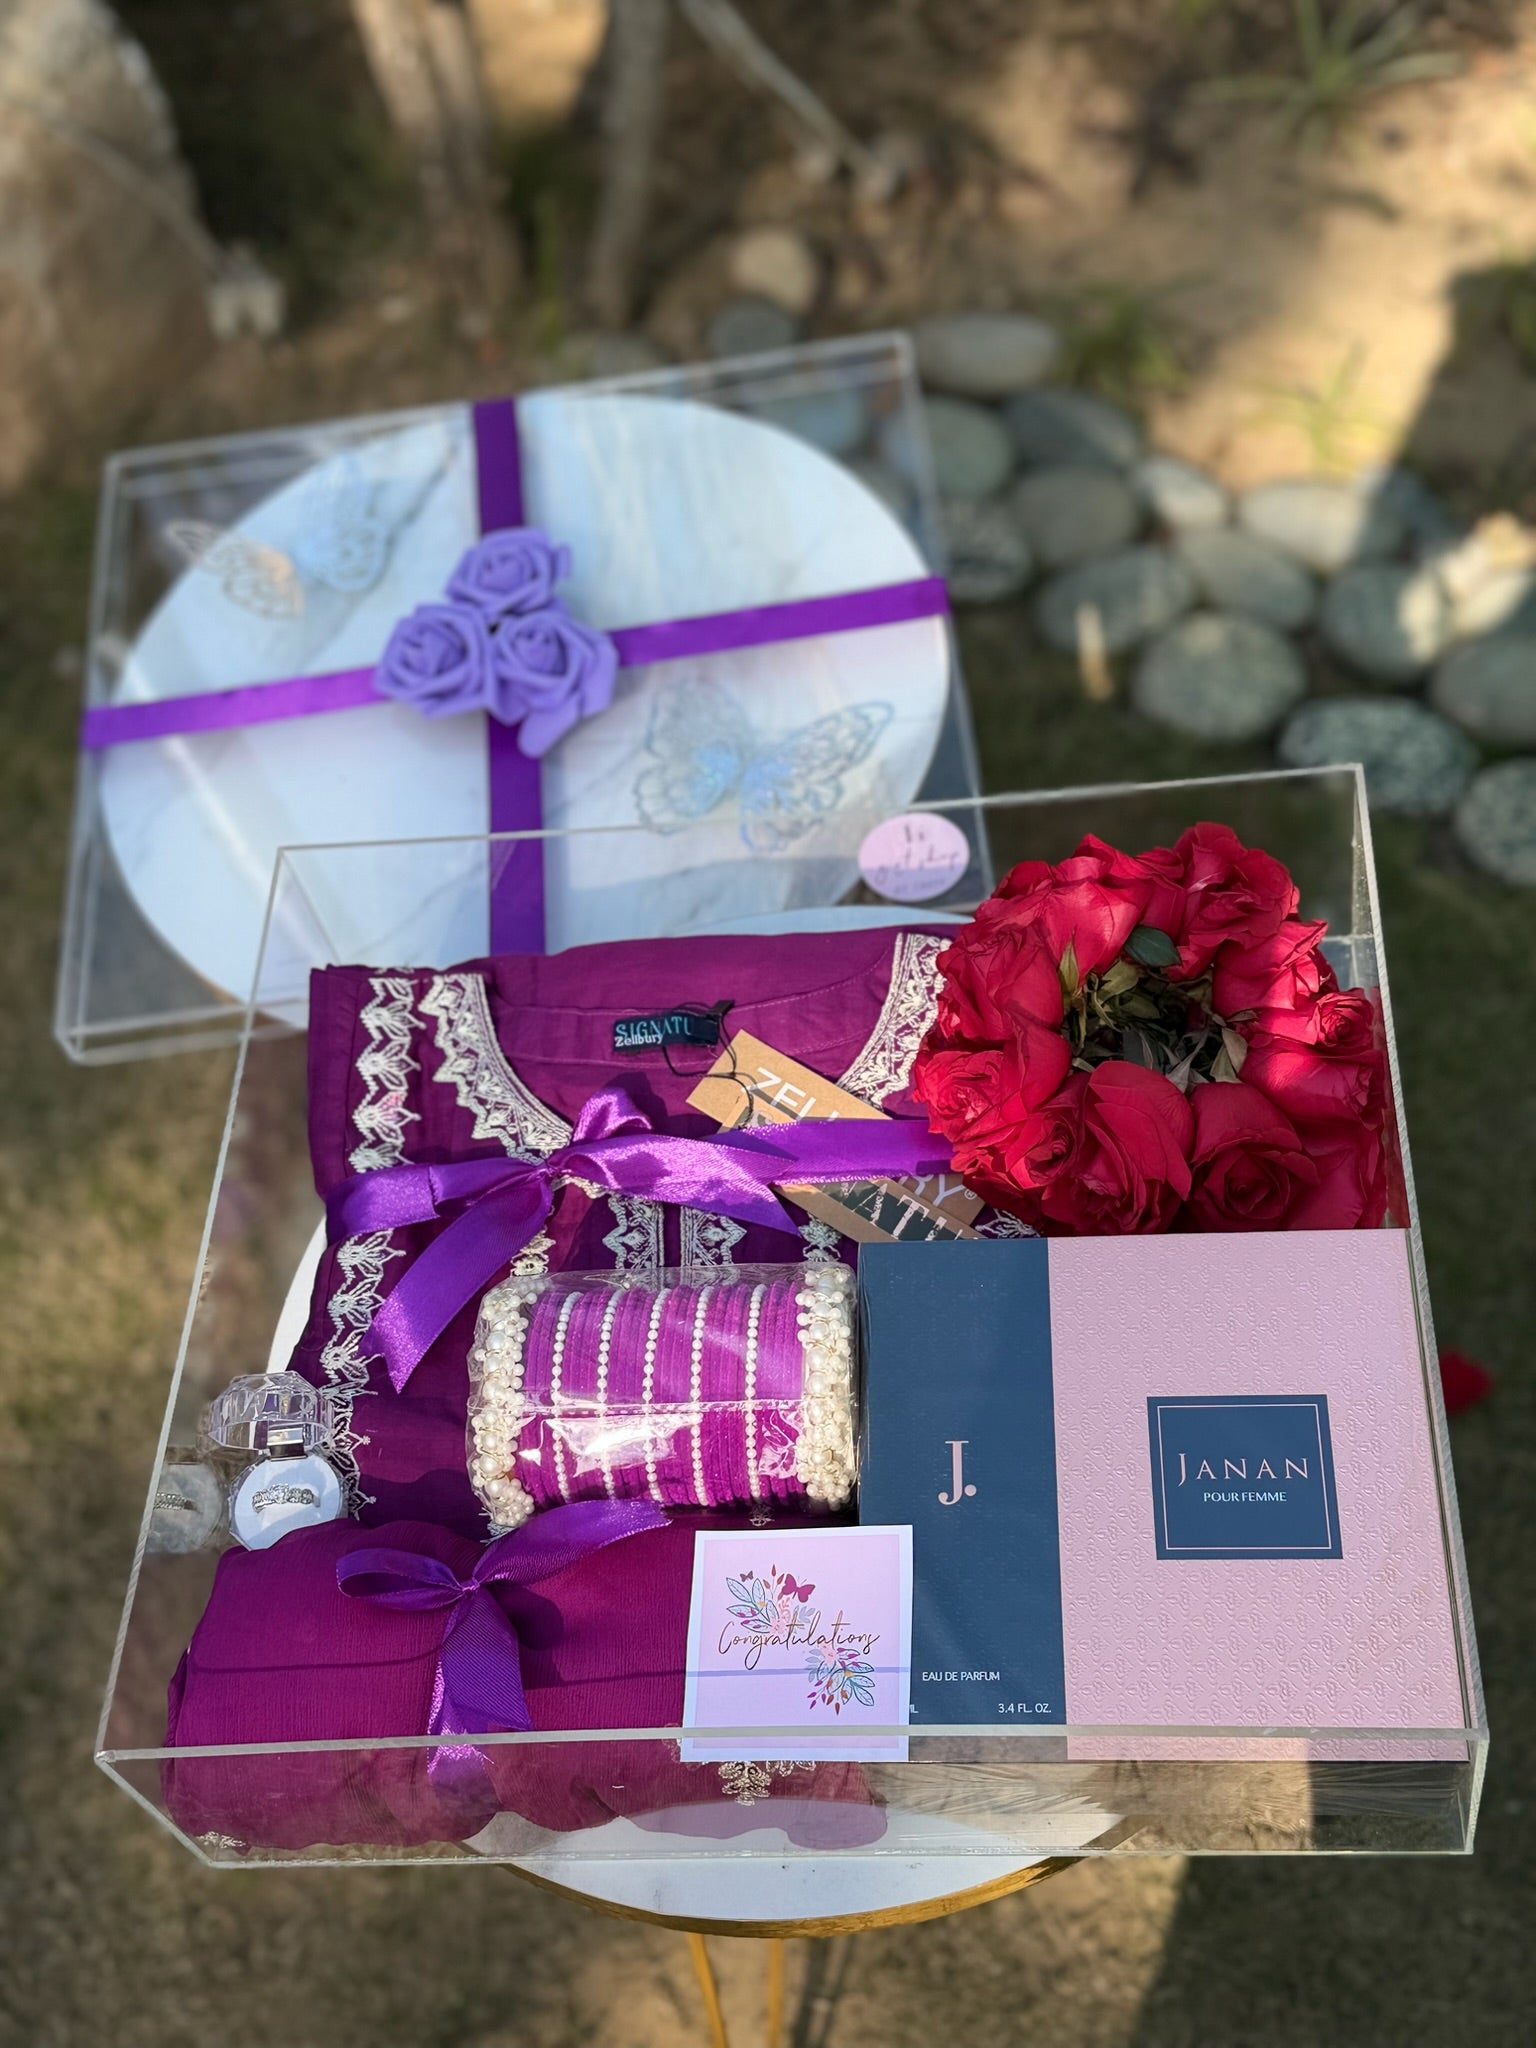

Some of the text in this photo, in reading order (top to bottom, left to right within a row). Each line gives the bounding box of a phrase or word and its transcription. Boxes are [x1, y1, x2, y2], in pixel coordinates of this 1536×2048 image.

[614, 1033, 662, 1047] Zellbury
[1178, 1453, 1309, 1487] JANAN
[1203, 1491, 1287, 1502] POUR FEMME
[718, 1610, 880, 1670] Congratulations
[922, 1671, 1000, 1681] EAU DE PARFUM
[998, 1703, 1014, 1713] 3.4
[1035, 1703, 1052, 1713] OZ.
